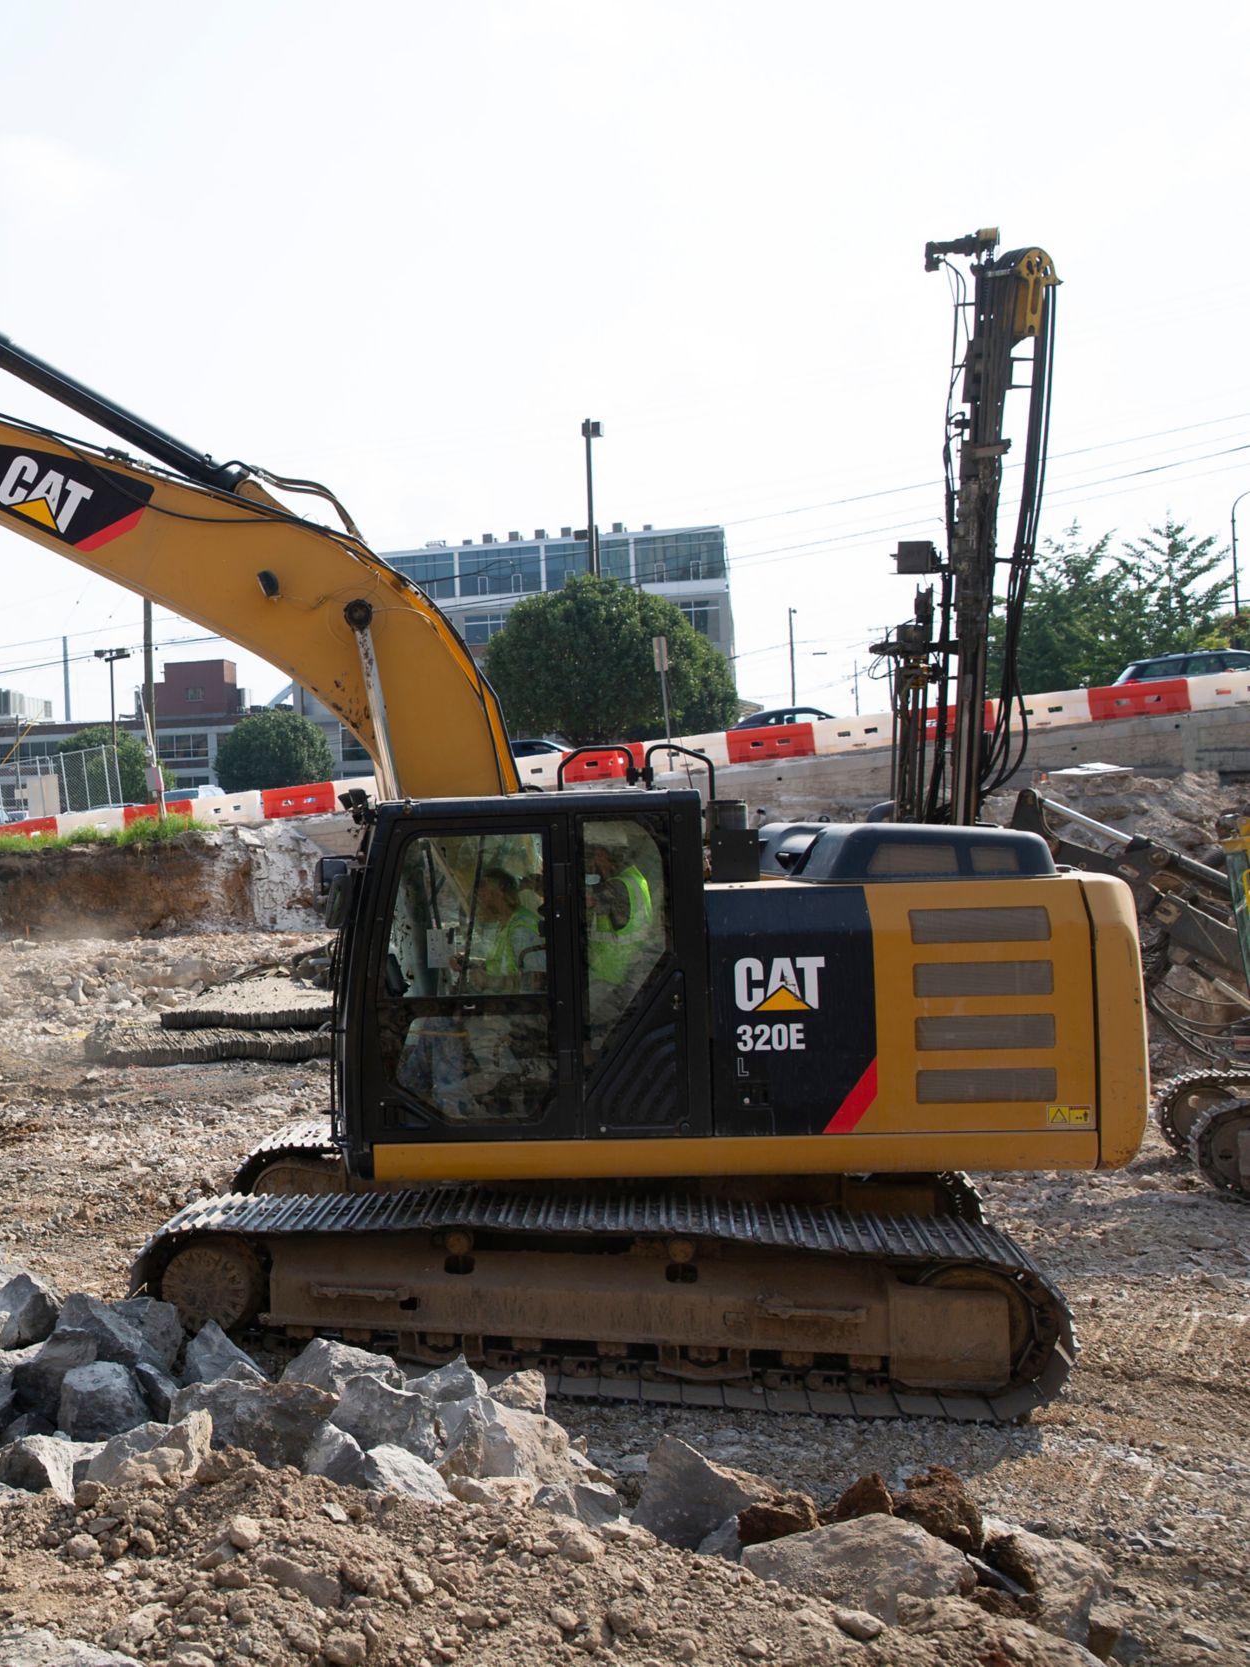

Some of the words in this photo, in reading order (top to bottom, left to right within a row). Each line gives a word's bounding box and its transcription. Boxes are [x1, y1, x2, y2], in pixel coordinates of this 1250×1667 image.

[734, 956, 825, 1012] CAT
[736, 1023, 806, 1051] 320E
[737, 1057, 750, 1077] L
